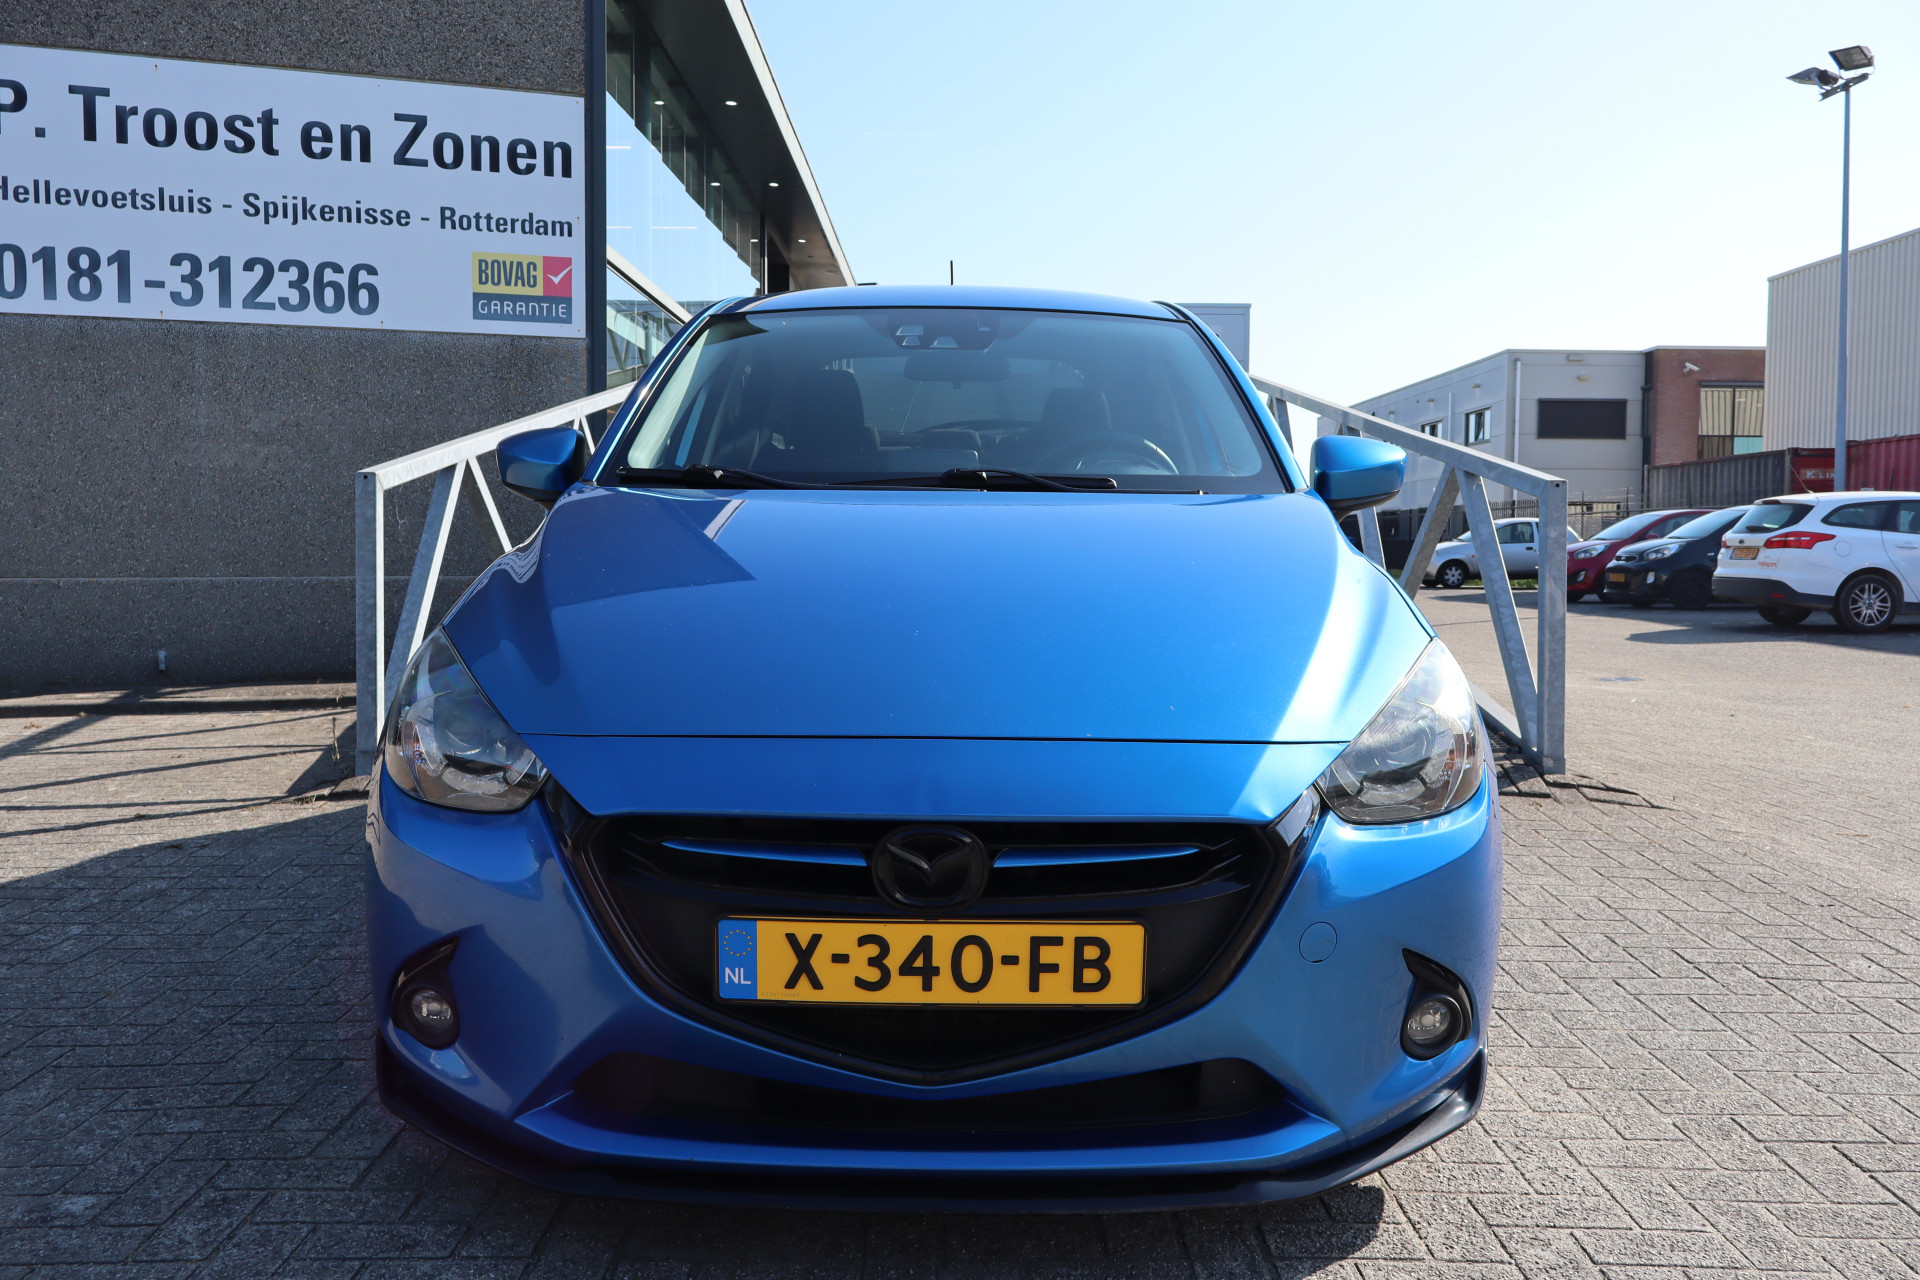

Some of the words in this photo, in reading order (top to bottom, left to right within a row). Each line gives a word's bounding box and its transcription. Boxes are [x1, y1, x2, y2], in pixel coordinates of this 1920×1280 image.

[68, 85, 279, 157] Troost
[301, 121, 372, 164] en
[393, 113, 572, 179] Zonen
[243, 192, 411, 227] Spijkenisse
[440, 207, 573, 238] Rotterdam
[0, 243, 380, 316] 0181-312366
[478, 259, 538, 288] BOVAG
[478, 300, 567, 318] GARANTIE
[725, 967, 752, 984] NL
[784, 933, 1112, 993] X-340-FB
